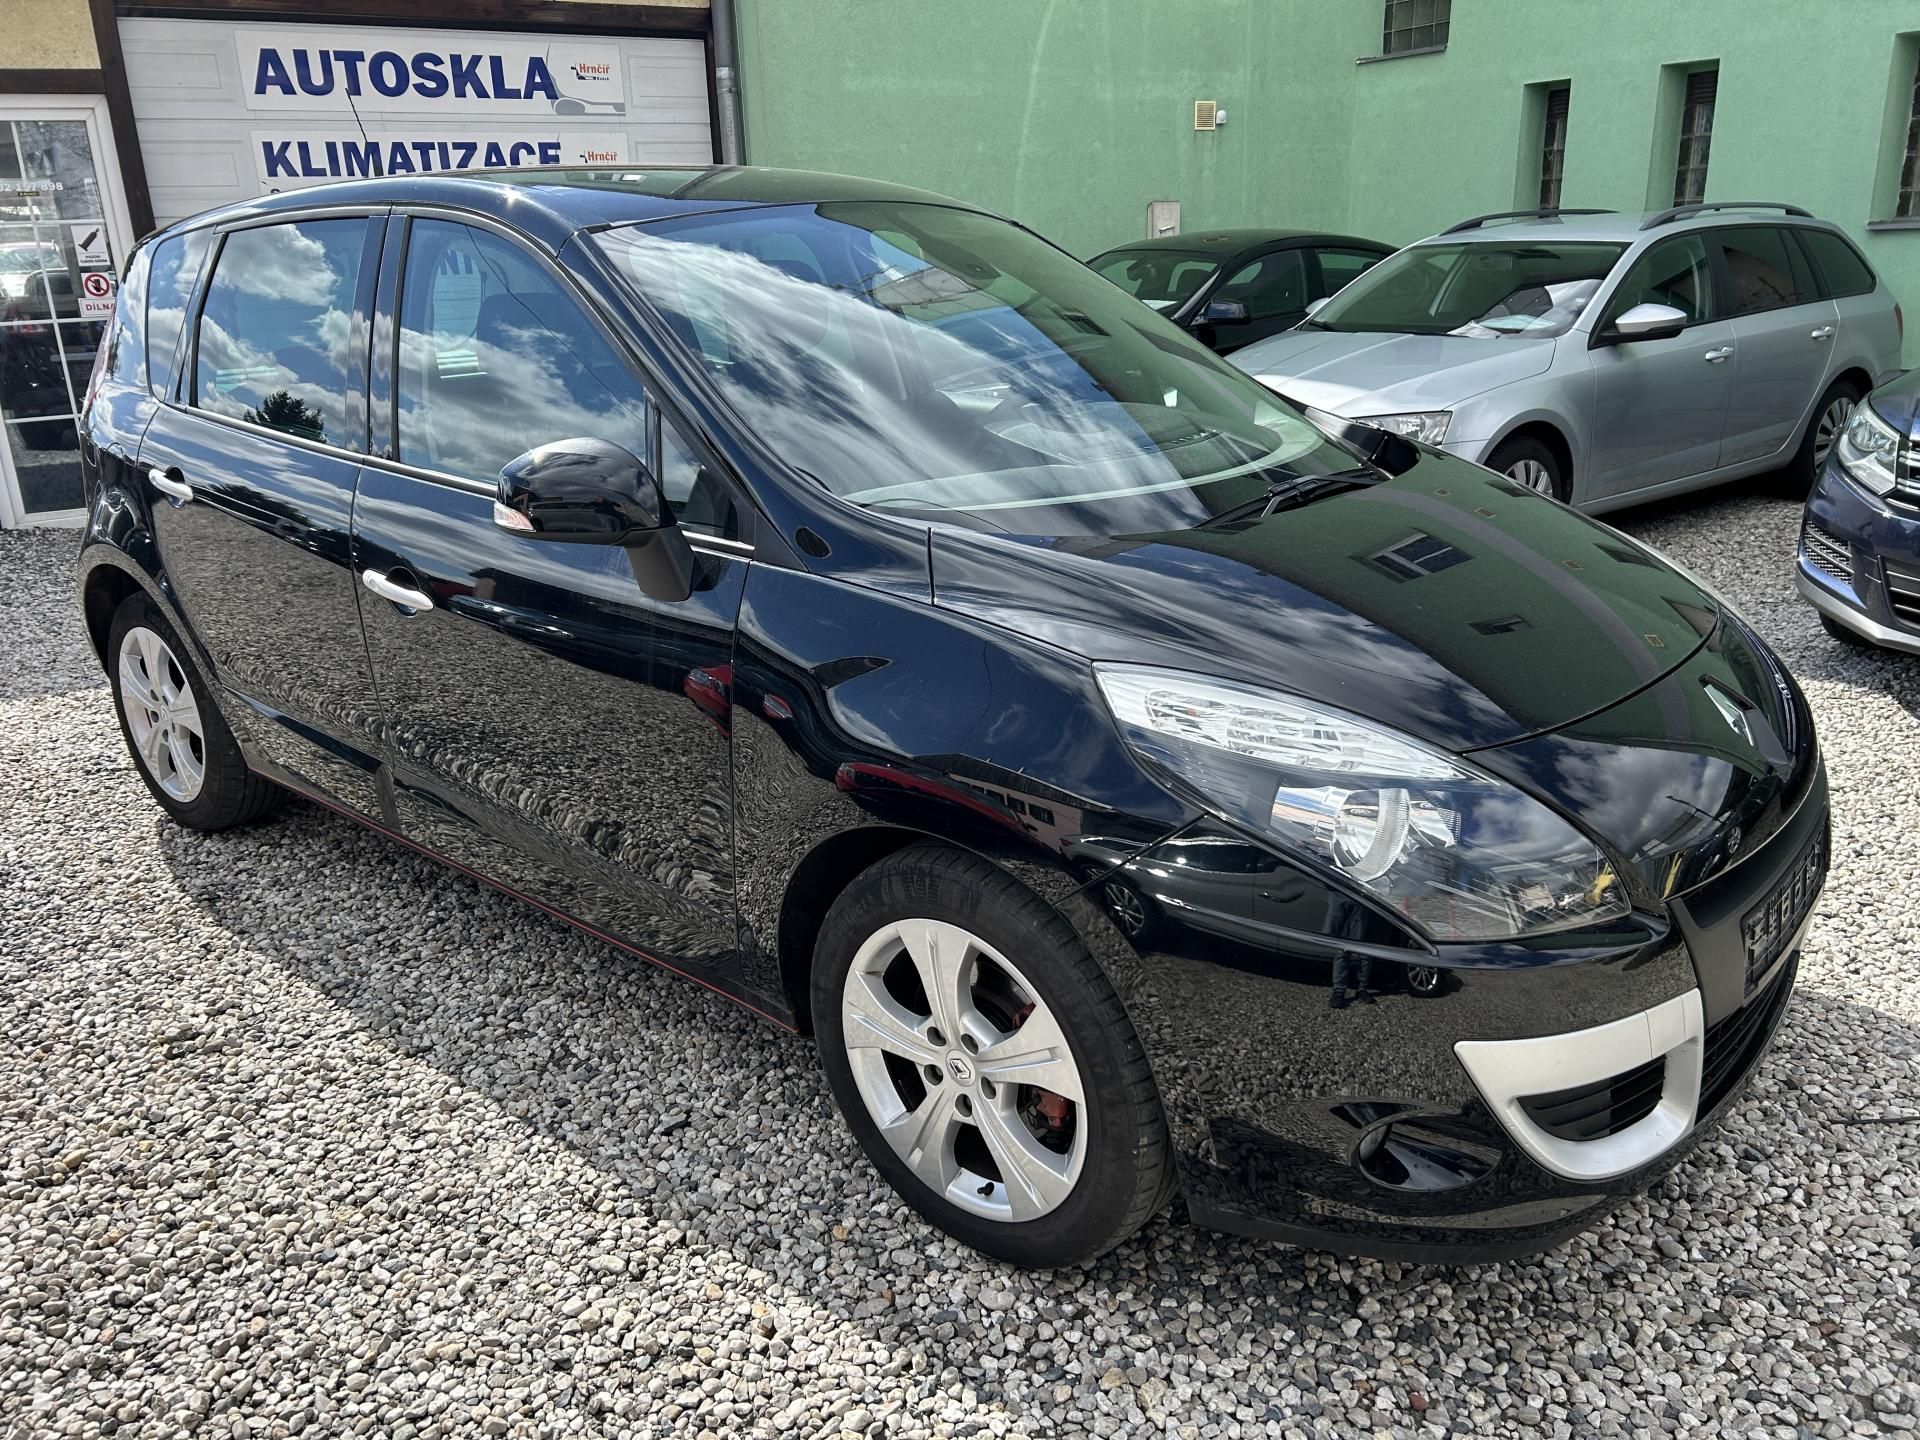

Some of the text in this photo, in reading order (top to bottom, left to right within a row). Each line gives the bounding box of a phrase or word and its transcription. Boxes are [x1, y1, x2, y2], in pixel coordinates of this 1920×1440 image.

[254, 48, 559, 100] AUTOSKLA
[579, 63, 610, 74] Hrnčíř
[262, 141, 561, 177] KLIMATIZACE
[587, 151, 618, 161] Hrnčíř
[16, 183, 37, 192] 157
[41, 181, 64, 191] 898
